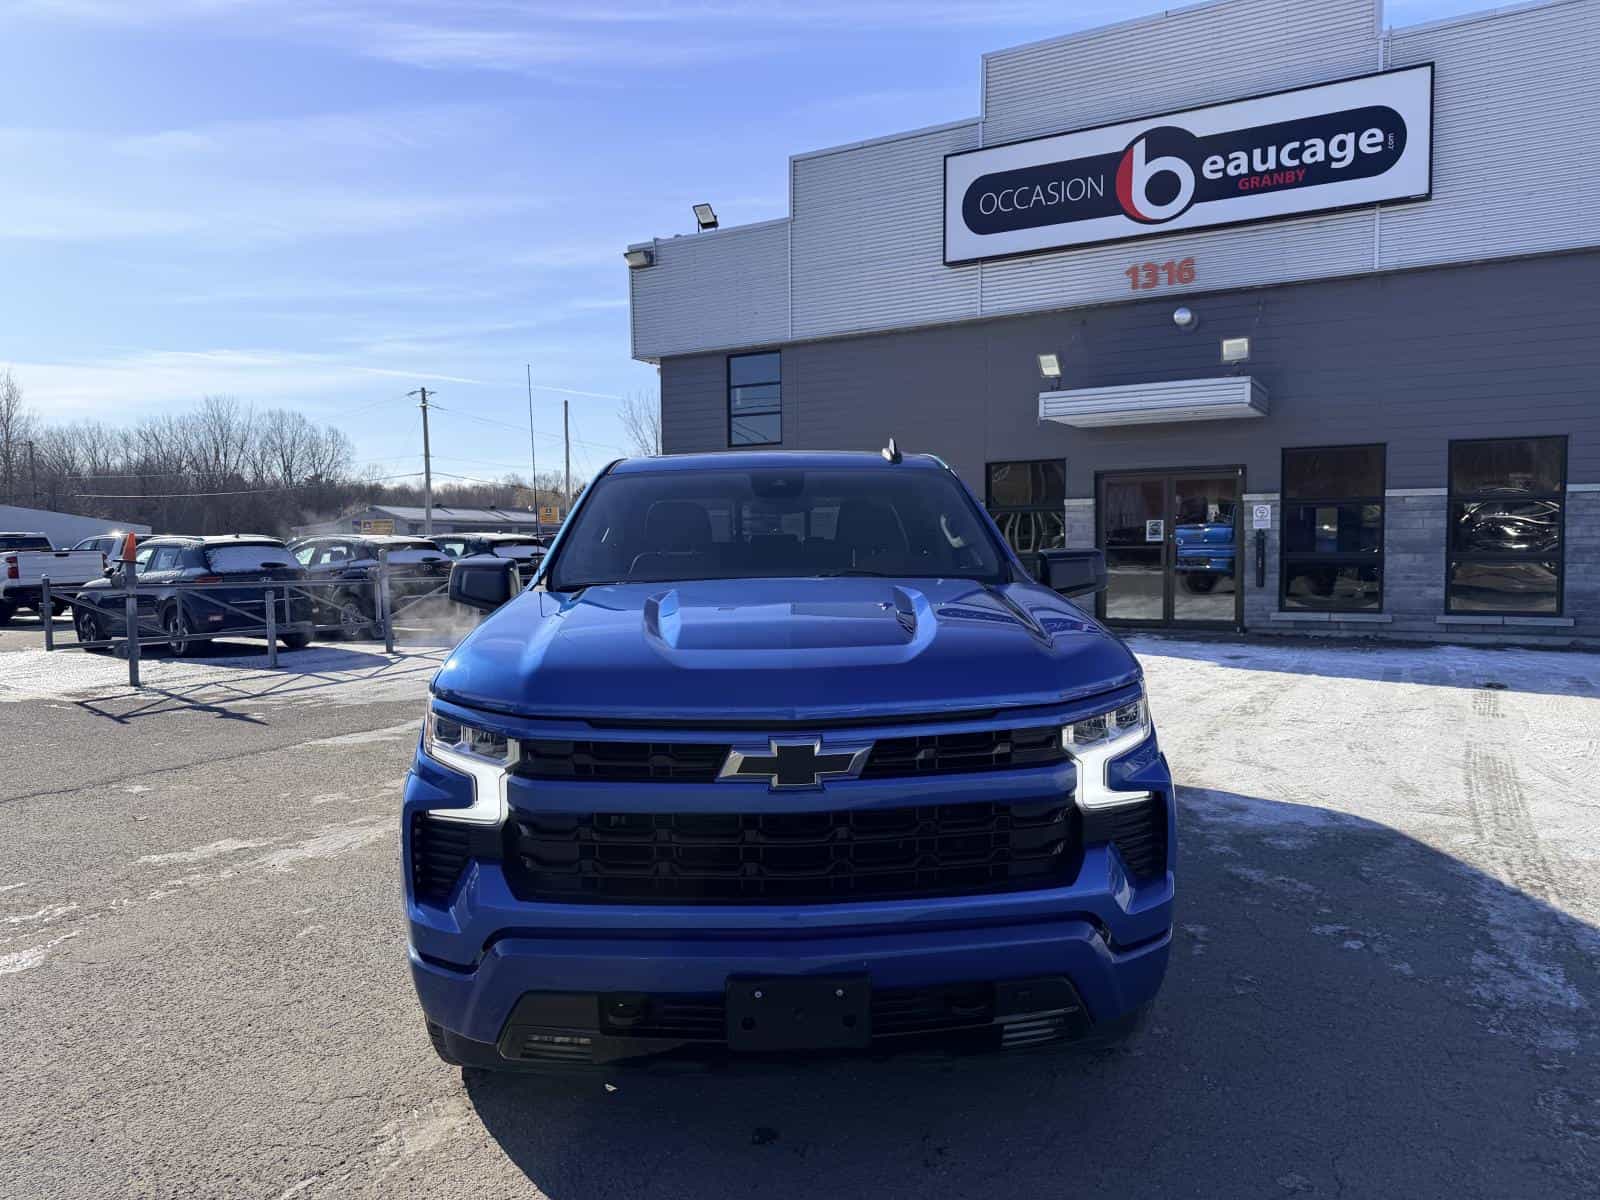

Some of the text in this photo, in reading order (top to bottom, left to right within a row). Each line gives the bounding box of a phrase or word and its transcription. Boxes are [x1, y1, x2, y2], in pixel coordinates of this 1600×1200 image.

[979, 175, 1104, 215] OCCASION
[1238, 169, 1306, 190] GRANBY
[1125, 258, 1196, 290] 1316
